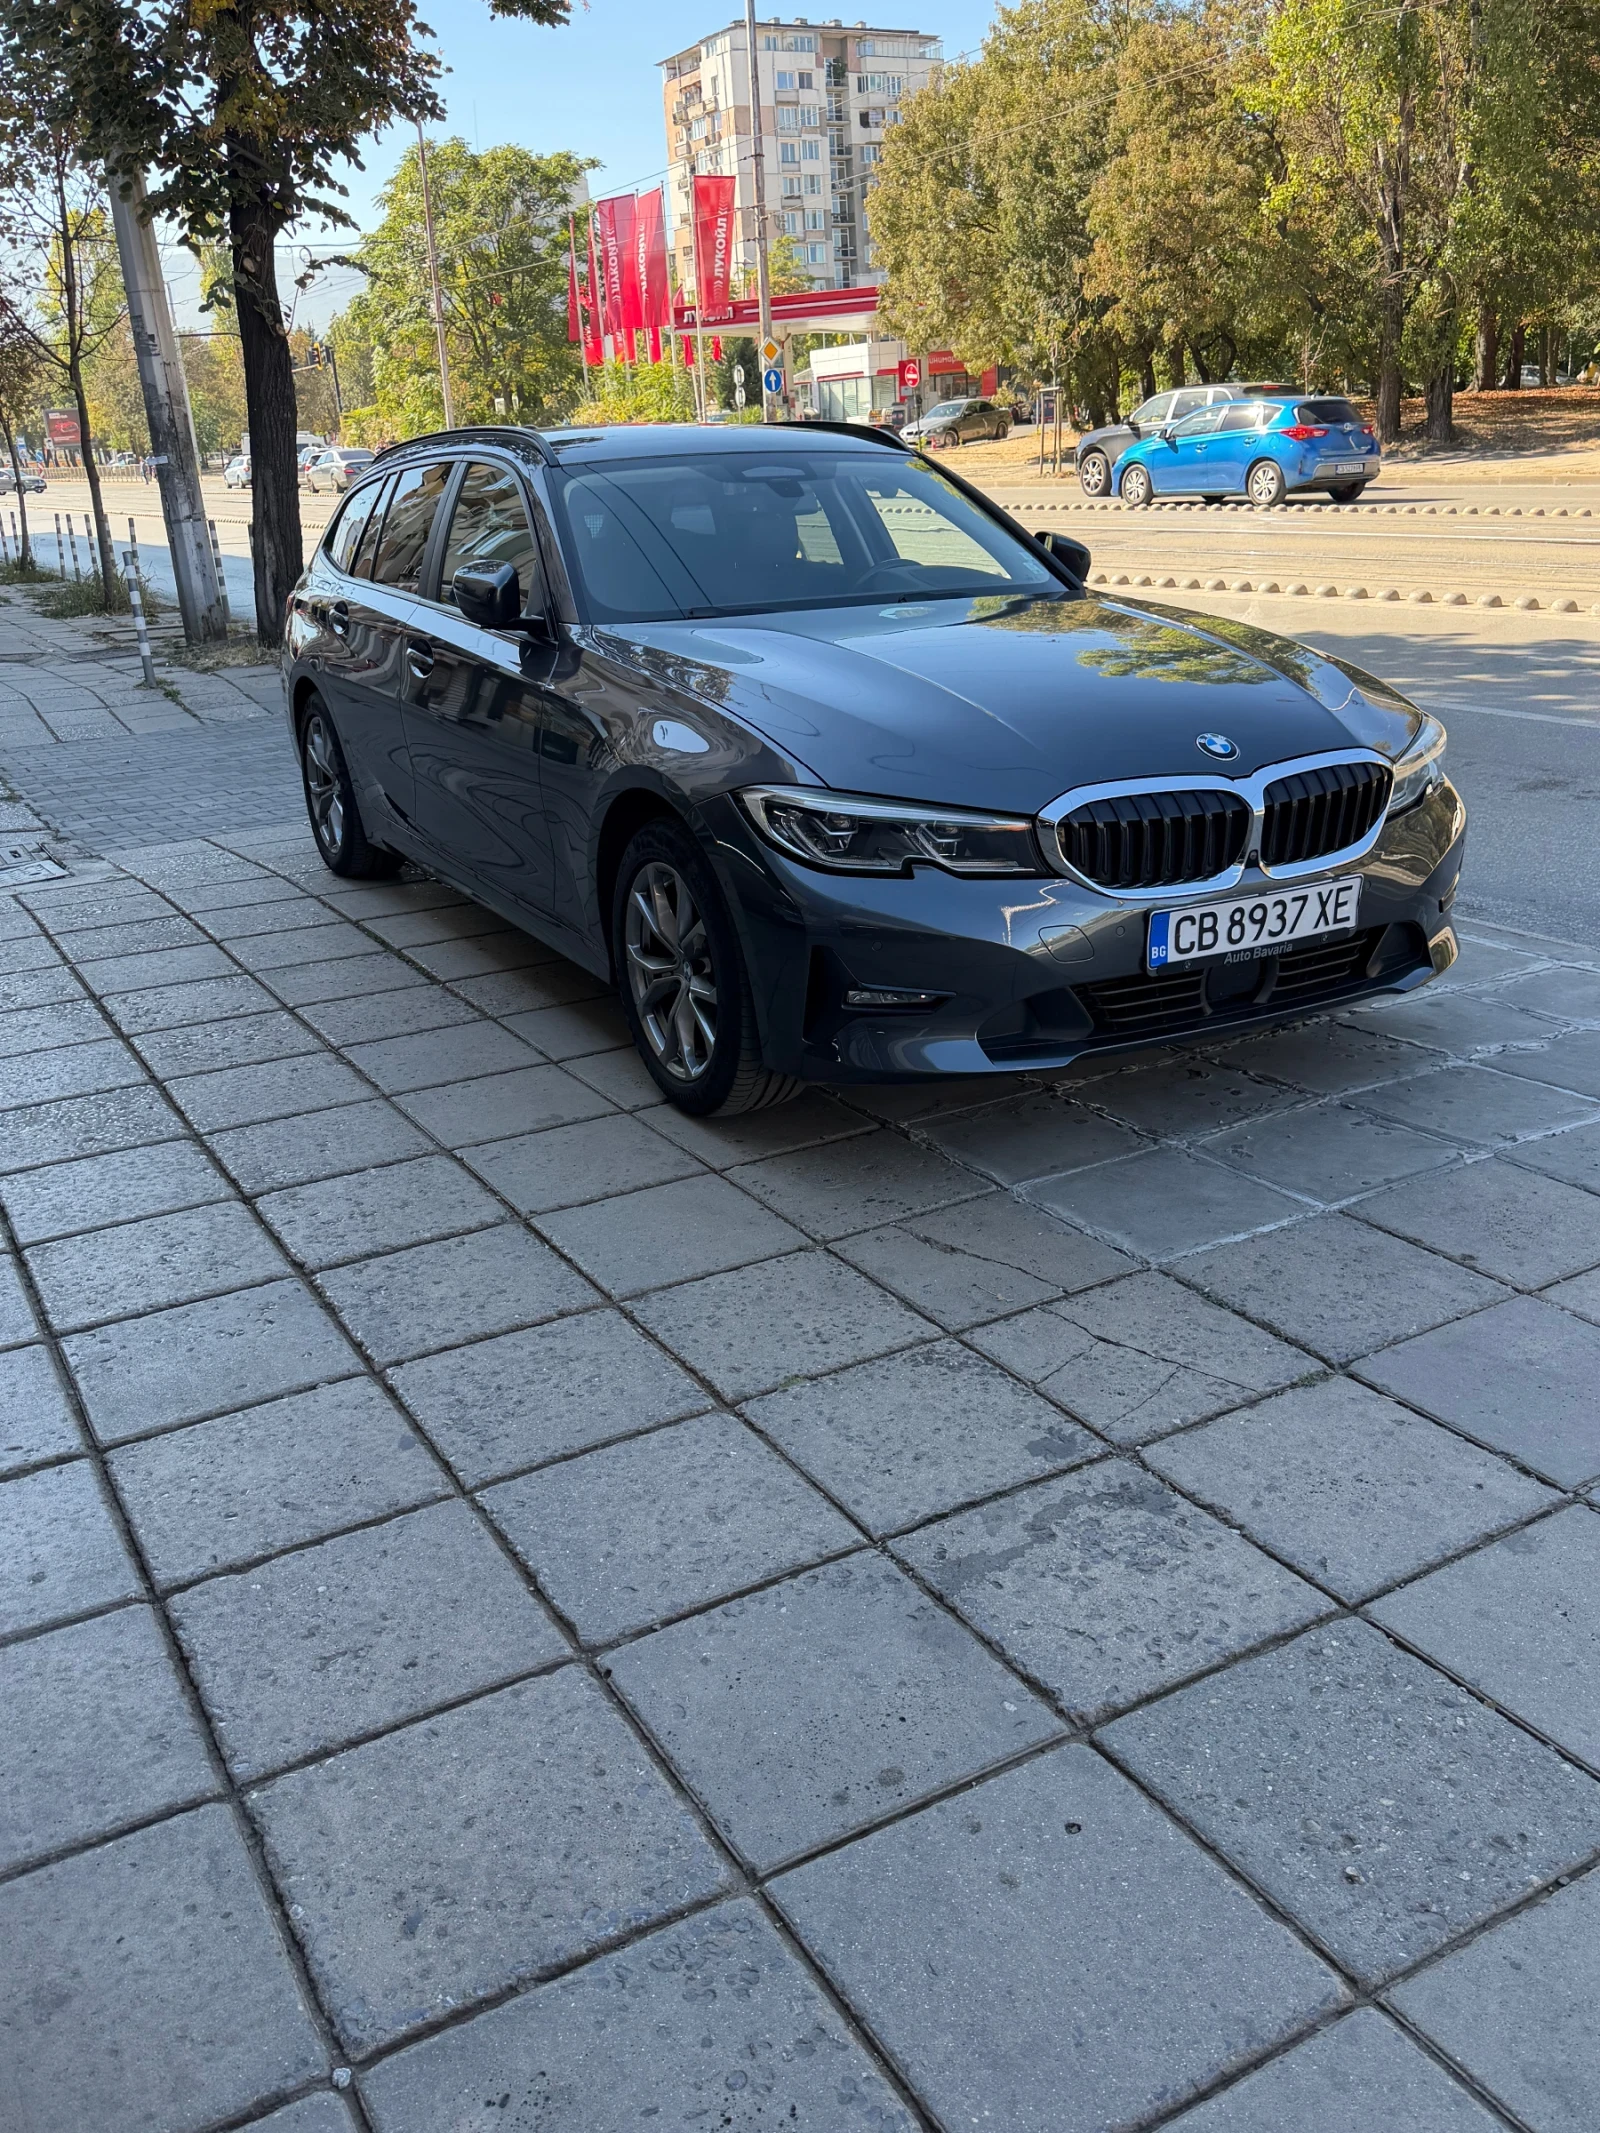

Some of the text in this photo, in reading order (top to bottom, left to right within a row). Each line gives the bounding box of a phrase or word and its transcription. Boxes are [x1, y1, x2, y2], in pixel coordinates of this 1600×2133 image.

[714, 218, 728, 278] ЛУКОЙЛ
[1174, 885, 1354, 955] CB 8937 XE
[1151, 945, 1167, 960] BG
[1224, 941, 1293, 965] Auto Bavaria
